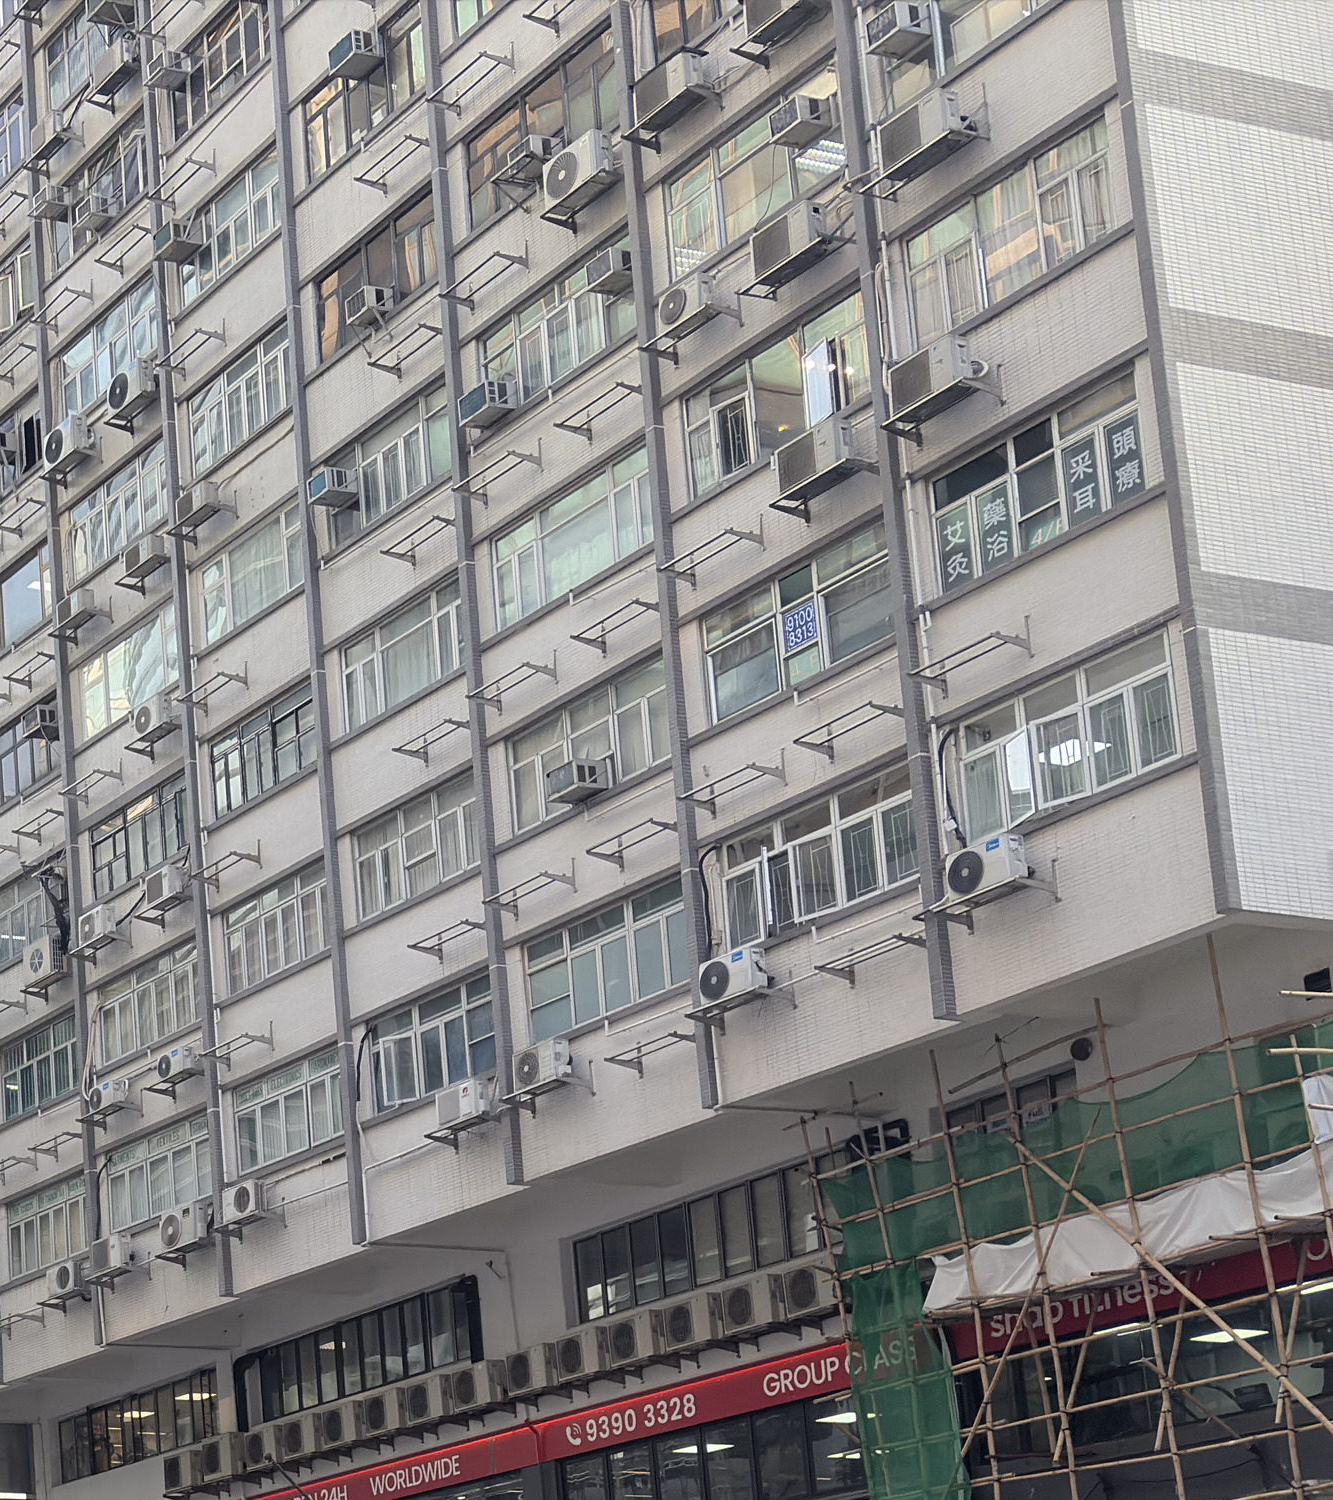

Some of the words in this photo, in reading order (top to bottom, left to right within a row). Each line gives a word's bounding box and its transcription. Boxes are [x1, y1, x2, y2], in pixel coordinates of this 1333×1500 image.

[1070, 449, 1096, 513] 采耳
[1111, 425, 1142, 492] 頭療
[943, 520, 970, 583] 艾灸
[983, 498, 1009, 562] 藥浴
[786, 607, 813, 630] 9100
[788, 623, 815, 647] 8313
[763, 1356, 839, 1397] GROUP
[585, 1408, 637, 1442] 9390
[643, 1393, 696, 1428] 3328
[369, 1454, 461, 1496] WORLDWIDE
